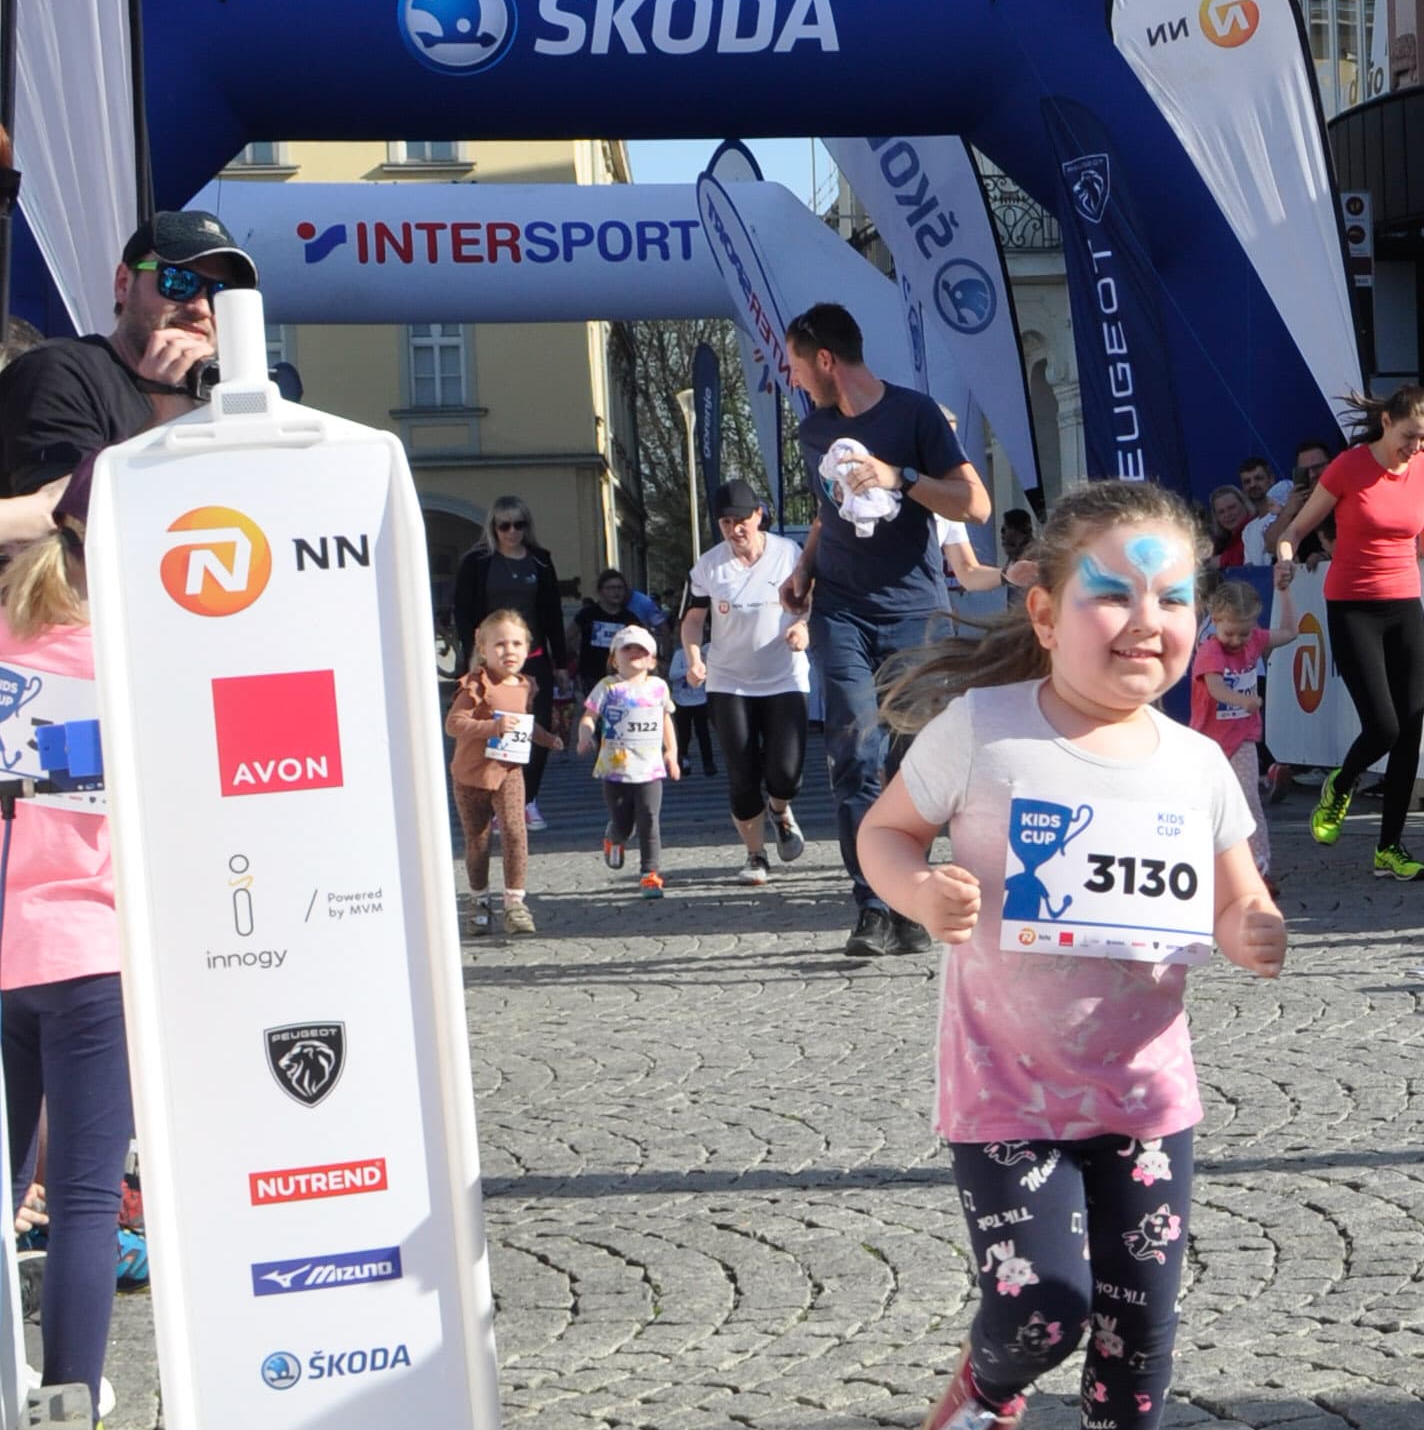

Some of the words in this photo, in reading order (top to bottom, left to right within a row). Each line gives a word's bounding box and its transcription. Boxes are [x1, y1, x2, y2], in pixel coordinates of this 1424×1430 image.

[356, 219, 700, 265] INTERSPORT
[1087, 238, 1145, 483] EUGEOT
[292, 533, 371, 572] NN
[627, 721, 658, 732] 3122
[232, 755, 329, 787] AVON
[1020, 812, 1062, 829] KIDS
[1157, 811, 1185, 825] KIDS
[1020, 830, 1057, 845] CUP
[1156, 825, 1182, 837] CUP
[1083, 853, 1198, 901] 3130
[327, 887, 383, 904] Powered
[328, 907, 345, 920] by
[349, 902, 384, 916] MVM
[206, 948, 288, 971] innogy
[271, 1027, 338, 1043] PEUGEOT
[257, 1165, 382, 1199] NUTREND
[308, 1344, 412, 1380] ŠKODA
